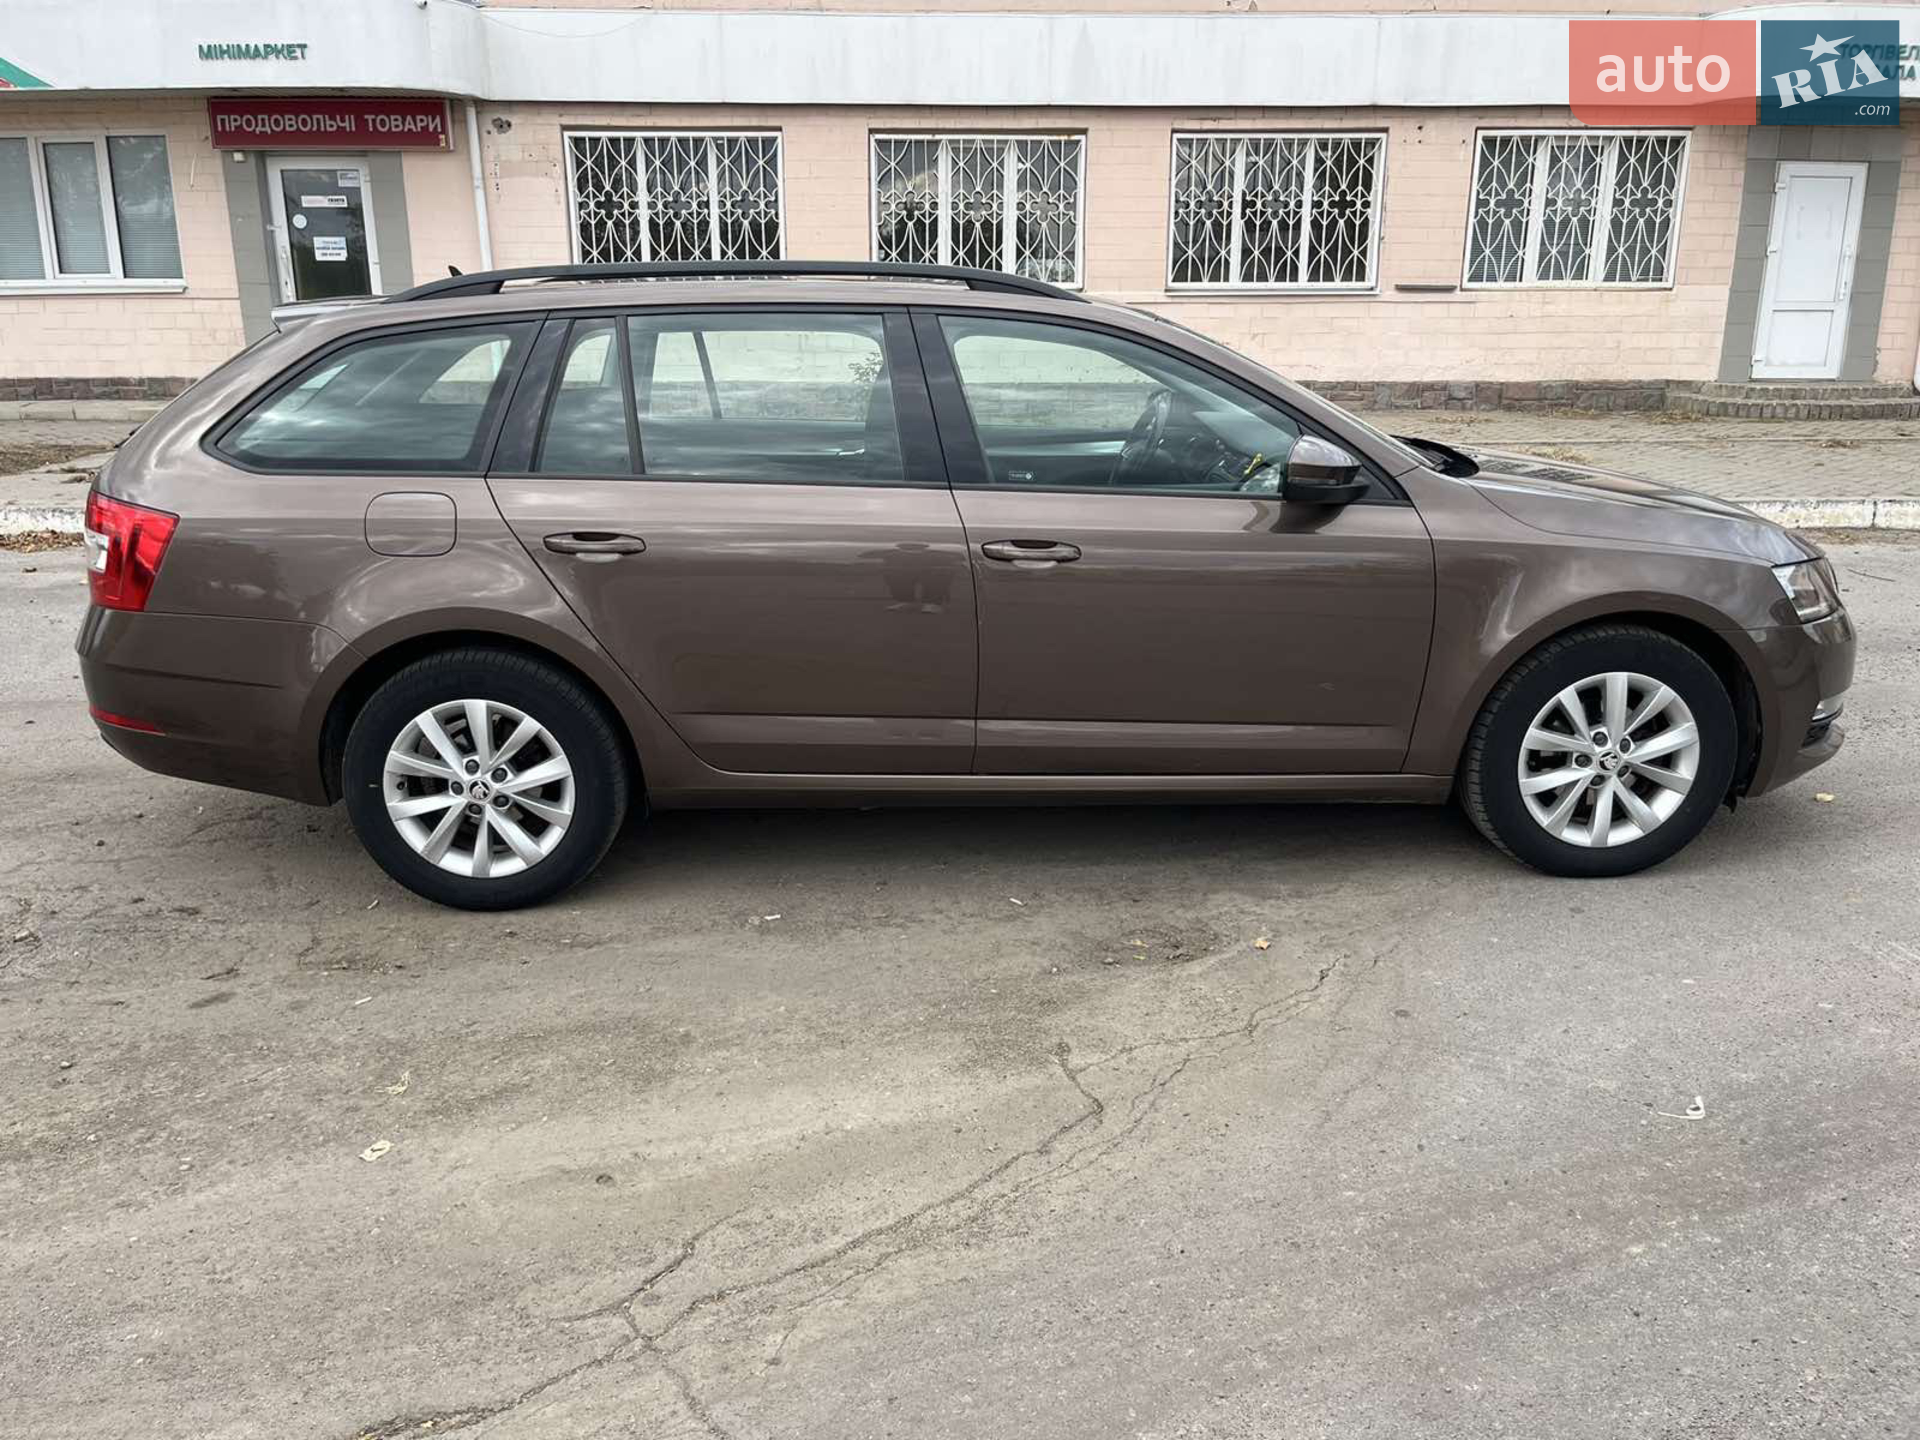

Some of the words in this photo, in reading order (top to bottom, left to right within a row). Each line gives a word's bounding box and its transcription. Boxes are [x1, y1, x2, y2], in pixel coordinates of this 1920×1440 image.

[198, 43, 308, 60] МІНІМАРКЕТ
[217, 114, 355, 133] ПРОДОВОЛЬЧІ
[365, 114, 442, 132] ТОВАРИ
